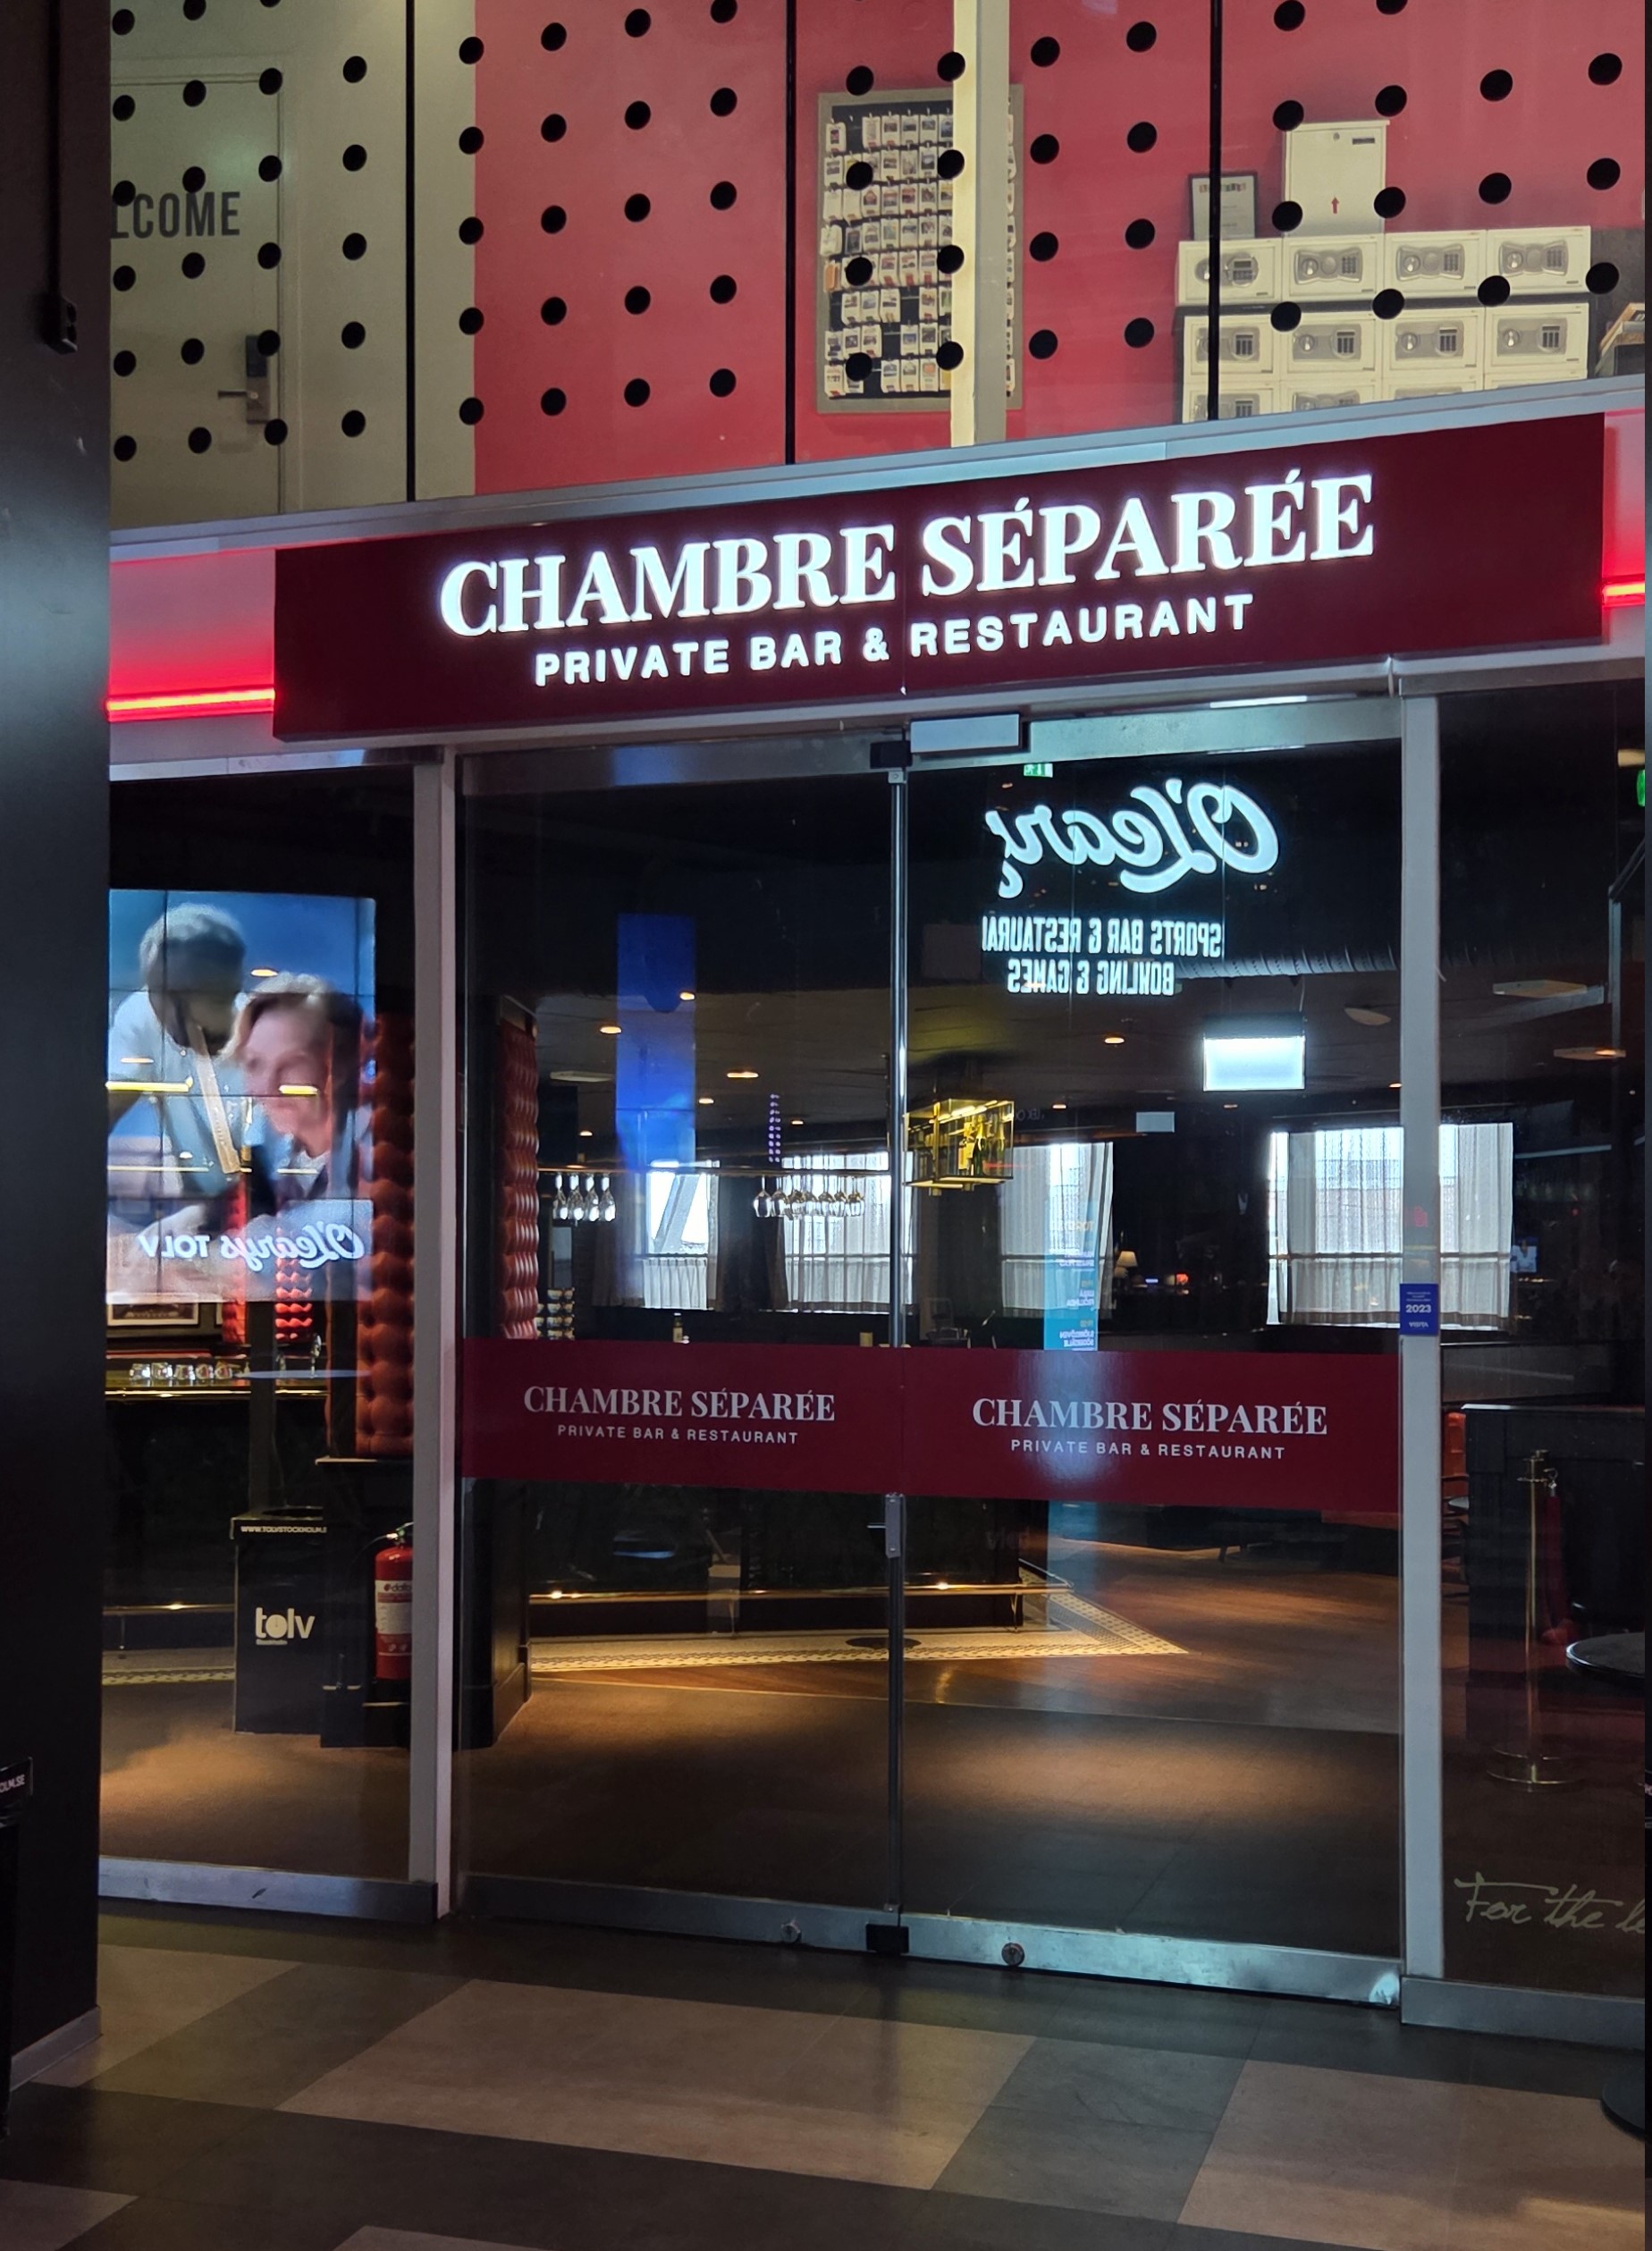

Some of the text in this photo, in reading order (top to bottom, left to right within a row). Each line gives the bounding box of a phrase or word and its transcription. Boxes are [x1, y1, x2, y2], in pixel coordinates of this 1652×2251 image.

[439, 468, 1374, 637] CHAMBRE SÉPARÉE
[535, 594, 1254, 687] PRIVATE BAR & RESTAURANT
[1405, 1303, 1432, 1313] 2023
[523, 1386, 836, 1422] CHAMBRE SÉPARÉE
[972, 1397, 1328, 1435] CHAMBRE SÉPARÉE
[557, 1424, 798, 1445] PRIVATE BAR & RESTAURANT
[1010, 1438, 1285, 1460] PRIVATE BAR & RESTAURANT
[255, 1606, 316, 1639] tolv
[1454, 1871, 1559, 1925] For
[1543, 1884, 1624, 1928] the
